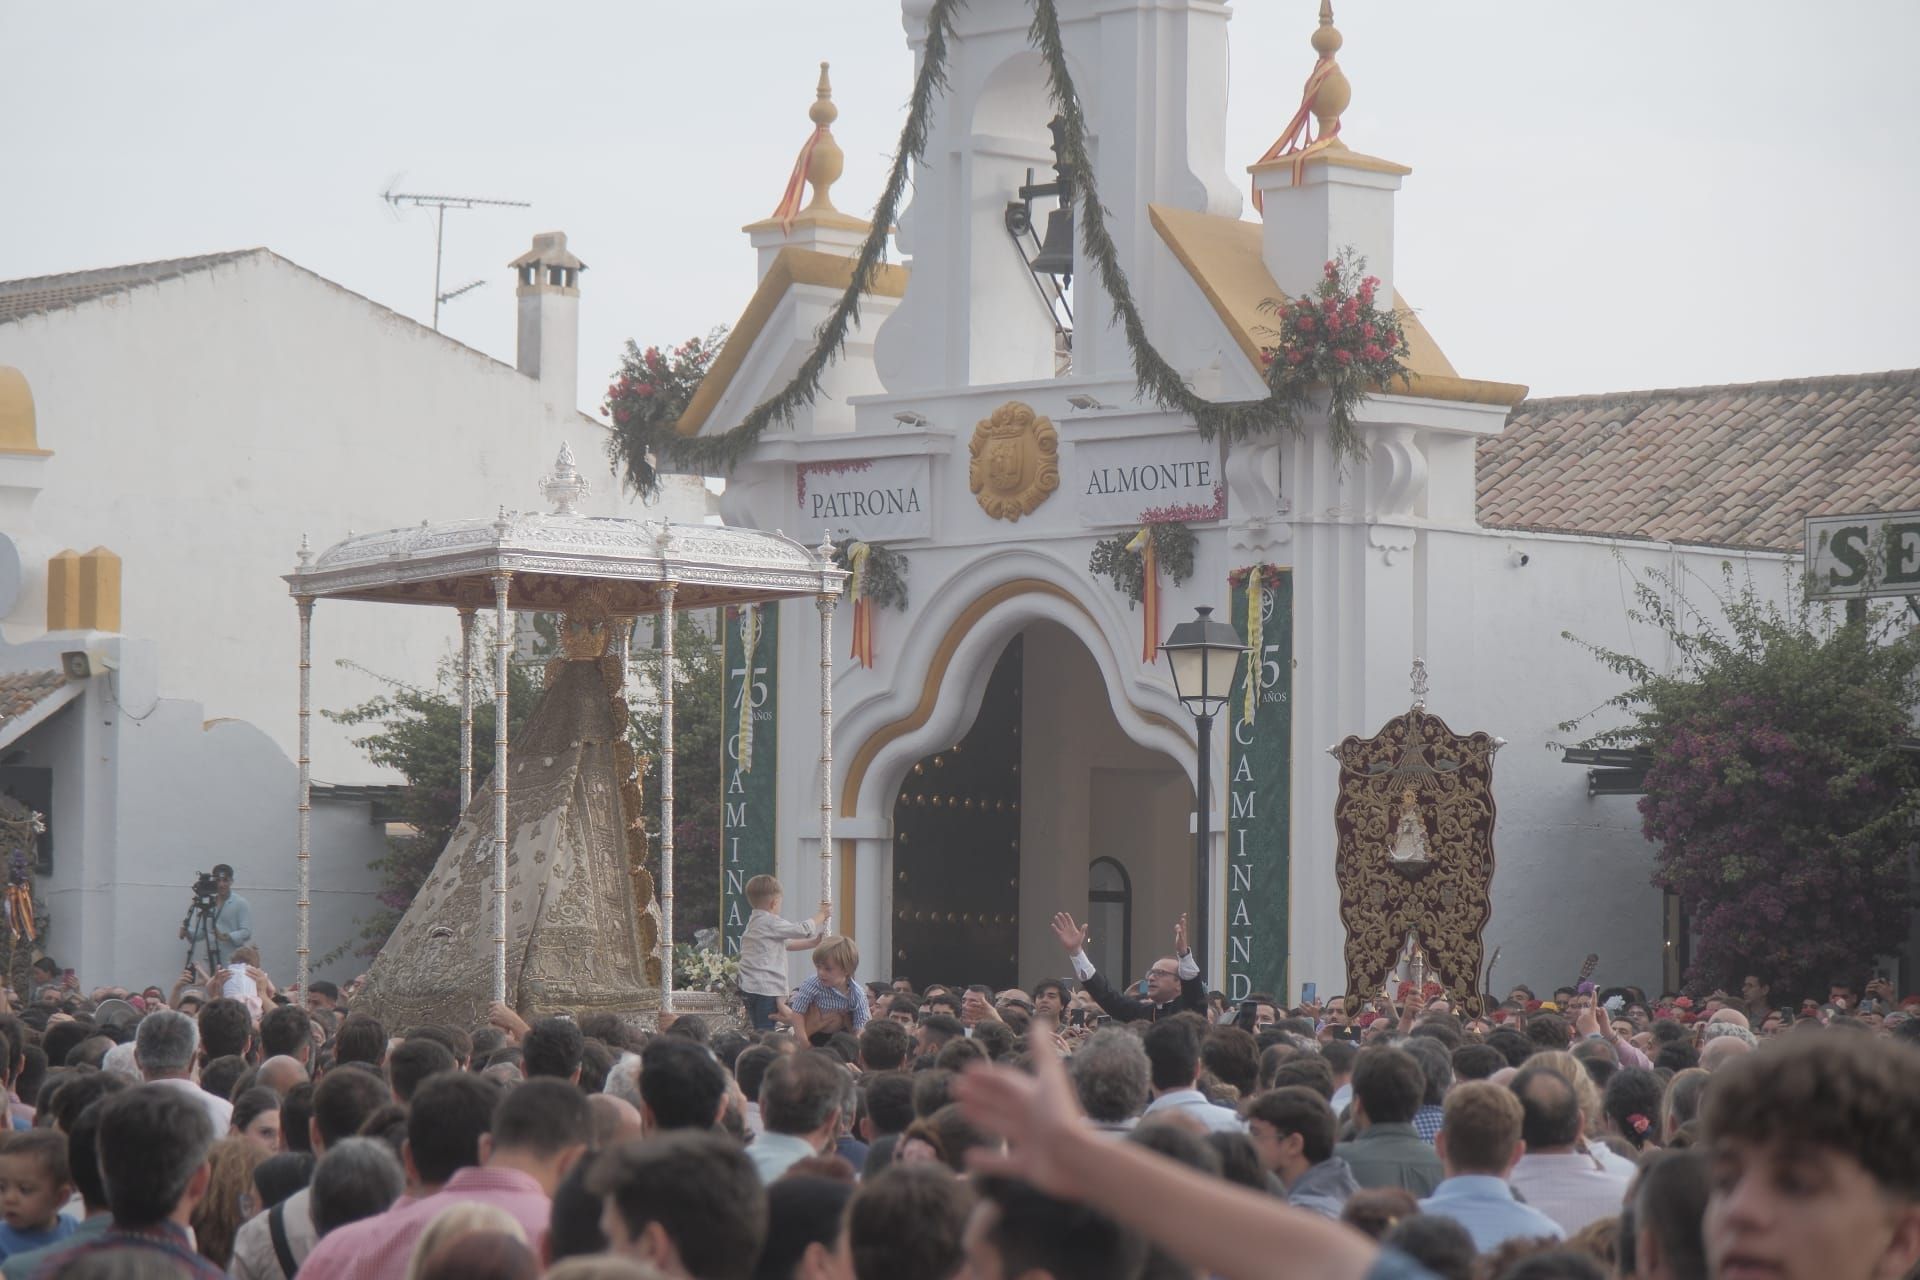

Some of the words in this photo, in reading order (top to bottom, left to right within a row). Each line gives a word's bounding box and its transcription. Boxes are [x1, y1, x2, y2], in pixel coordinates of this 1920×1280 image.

[1085, 461, 1211, 494] ALMONTE
[811, 487, 921, 518] PATRONA
[731, 667, 768, 709] 75
[1262, 690, 1287, 702] AÑOS
